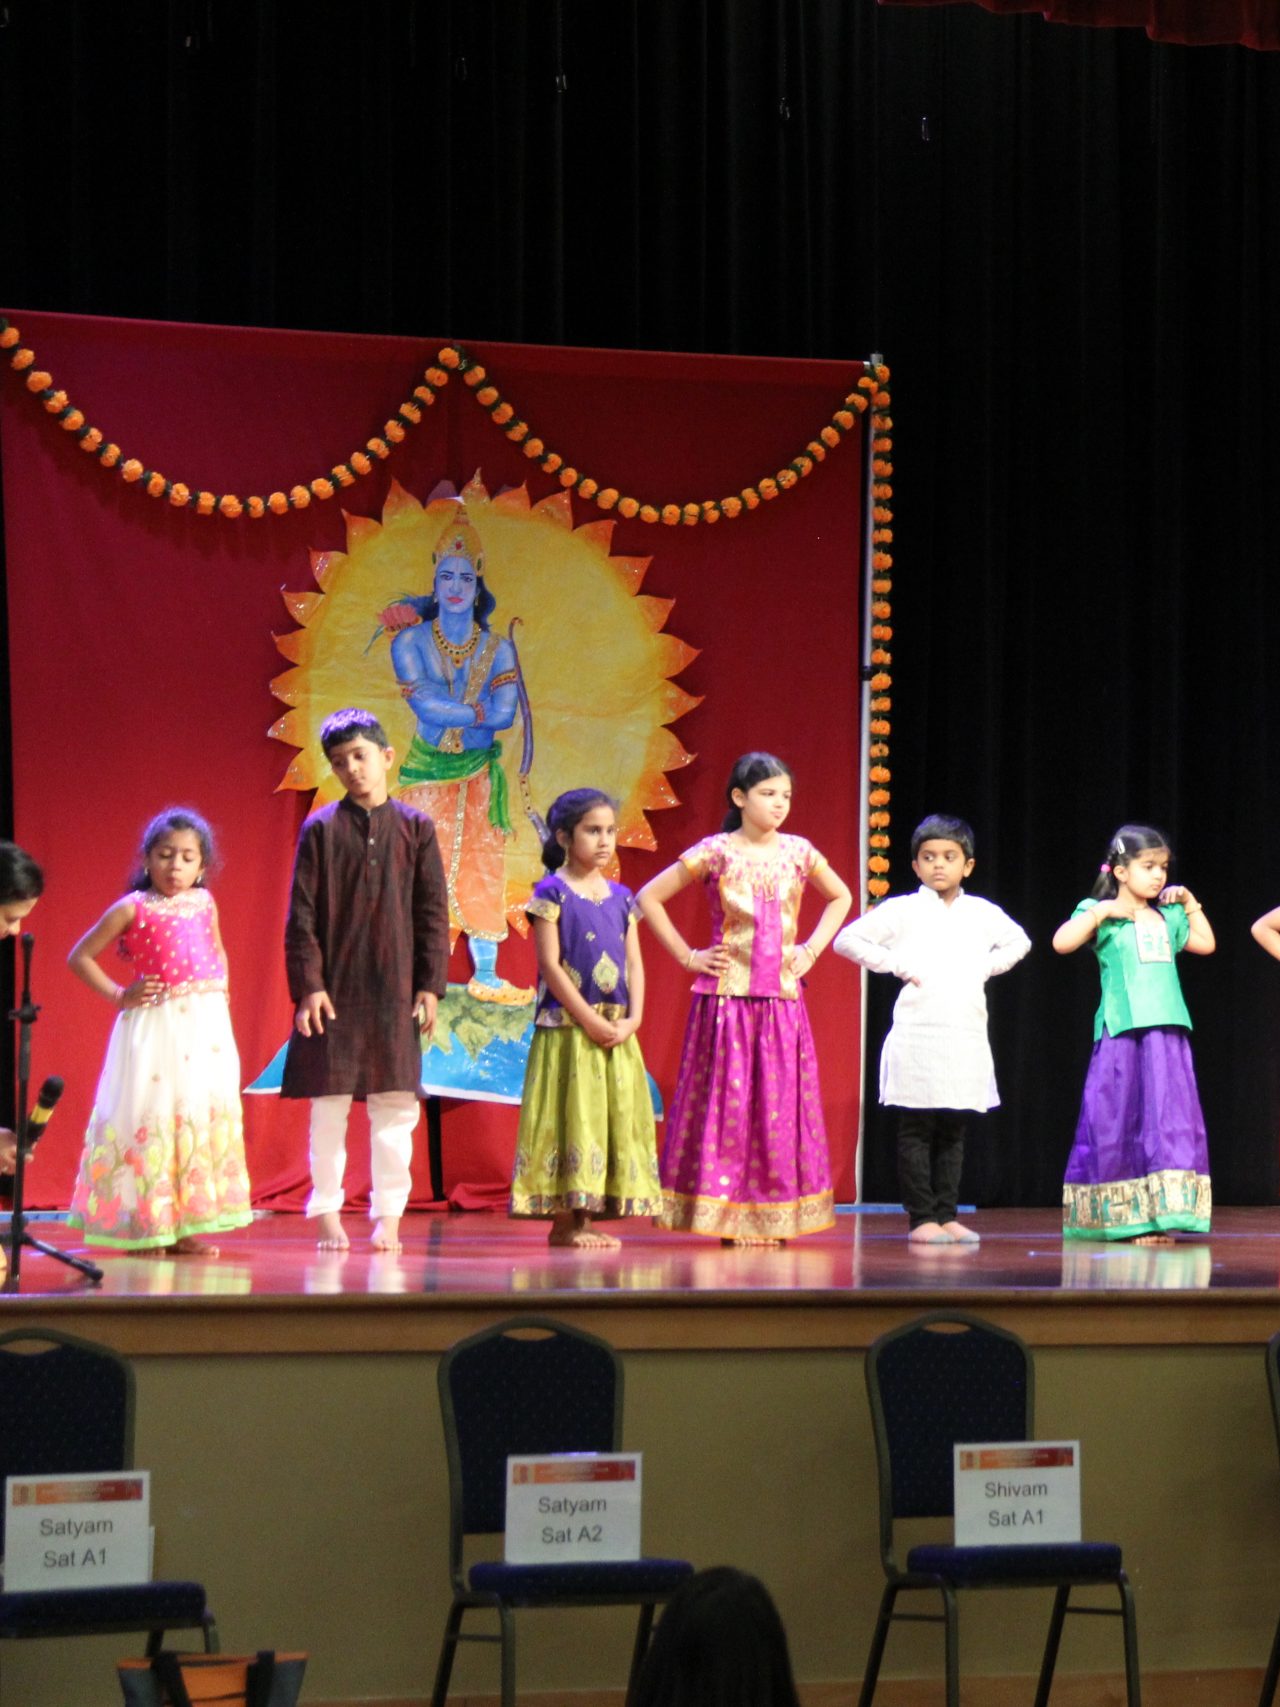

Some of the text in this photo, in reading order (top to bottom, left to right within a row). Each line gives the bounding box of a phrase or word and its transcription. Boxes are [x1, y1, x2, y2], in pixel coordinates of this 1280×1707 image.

[984, 1481, 1048, 1498] Shivam
[538, 1496, 607, 1517] Satyam
[988, 1509, 1044, 1527] Sat A1
[39, 1518, 114, 1539] Satyam
[541, 1524, 603, 1544] Sat A2
[43, 1547, 107, 1569] Sat A1
